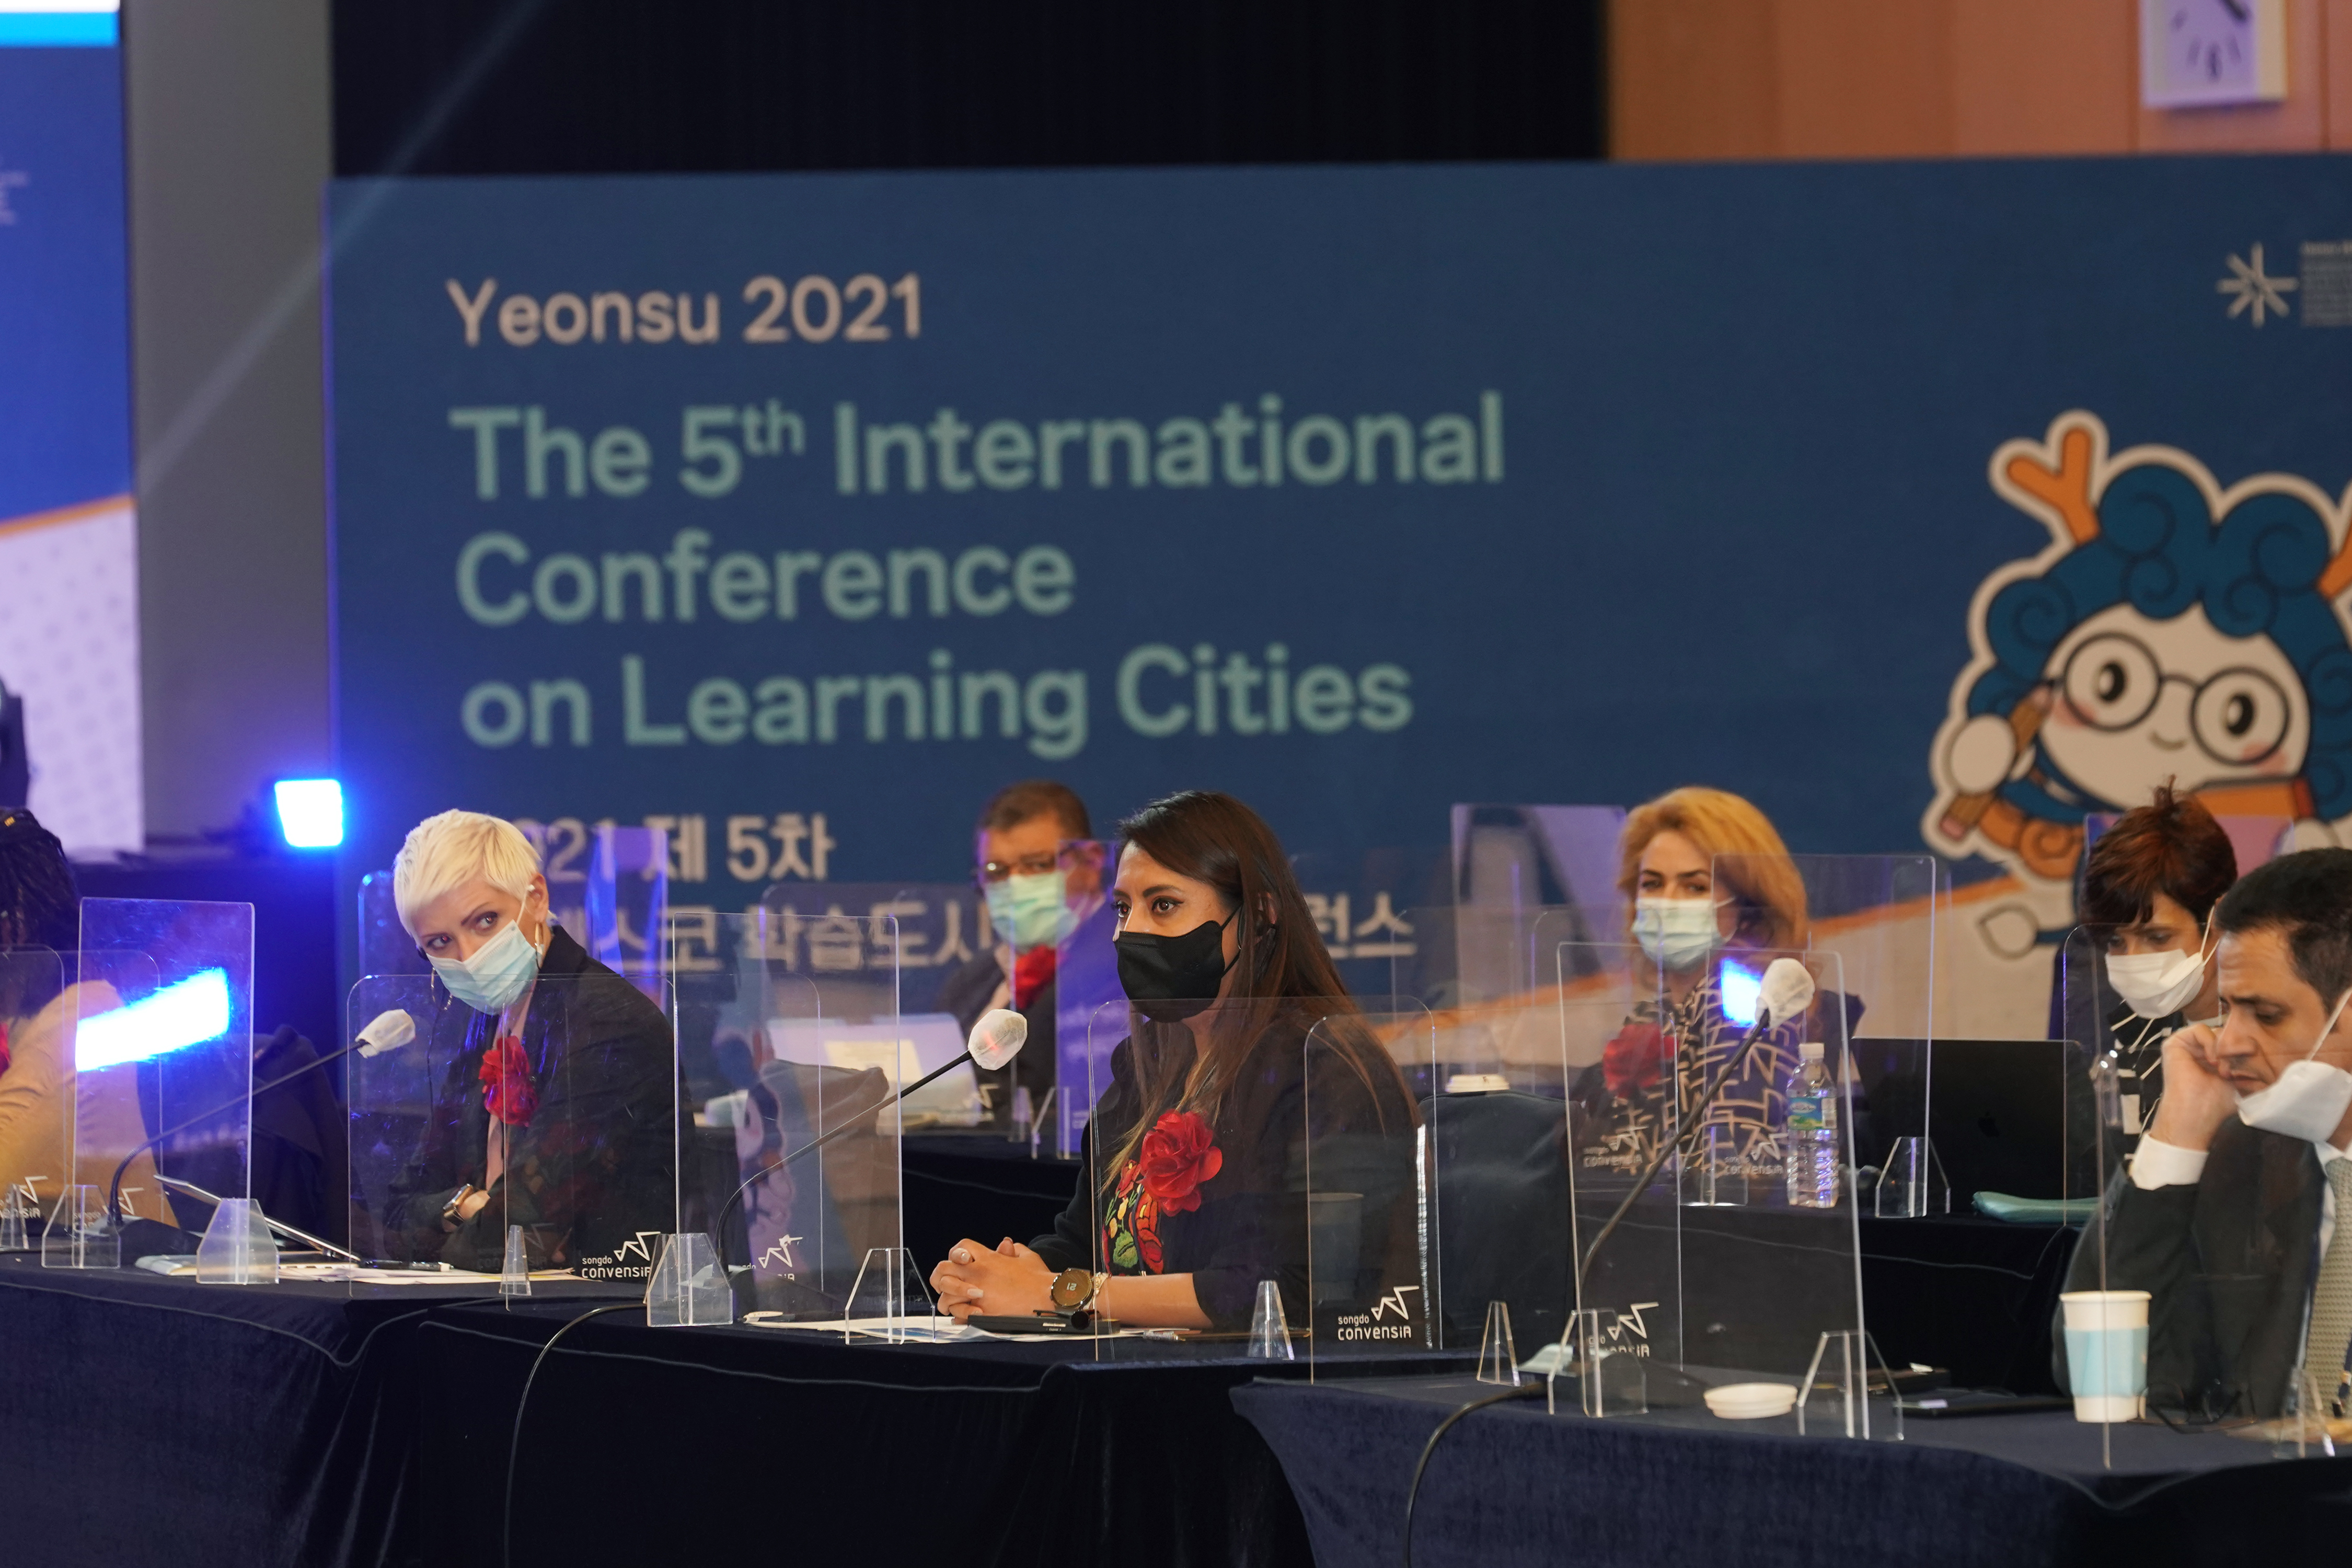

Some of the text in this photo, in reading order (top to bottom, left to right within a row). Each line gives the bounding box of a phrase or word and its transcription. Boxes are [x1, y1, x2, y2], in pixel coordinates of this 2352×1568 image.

[446, 273, 920, 347] Yeonsu 2021
[448, 390, 1503, 500] The 5th International
[455, 527, 1075, 626] Conference
[460, 643, 1413, 759] on Learning Cities
[642, 814, 707, 882] 제
[726, 812, 835, 882] 5차
[582, 1255, 613, 1266] songdo
[1338, 1313, 1369, 1327] songdo
